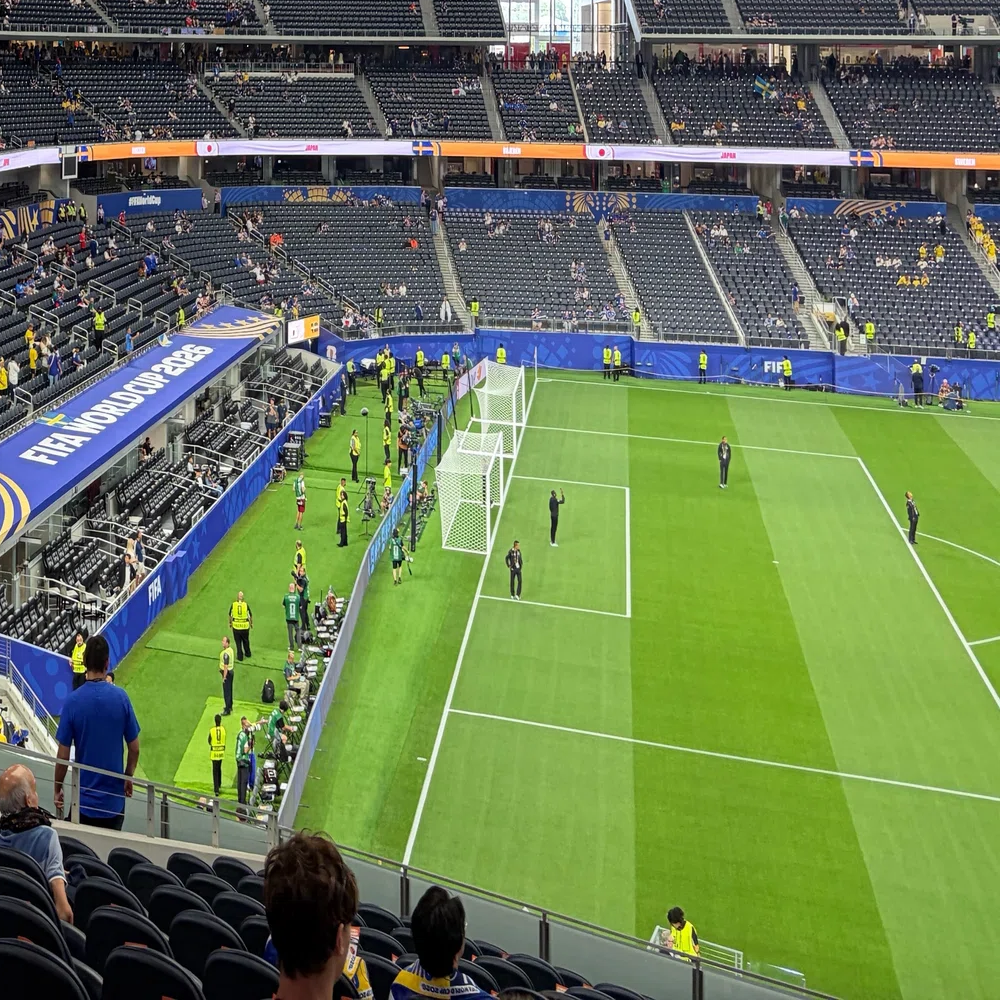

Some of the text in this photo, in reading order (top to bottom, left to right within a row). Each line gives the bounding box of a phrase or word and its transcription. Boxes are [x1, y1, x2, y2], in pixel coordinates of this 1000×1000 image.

[764, 360, 783, 373] FIF
[18, 343, 214, 466] FIFA WORLD CUP 2026
[148, 575, 162, 606] FIFA
